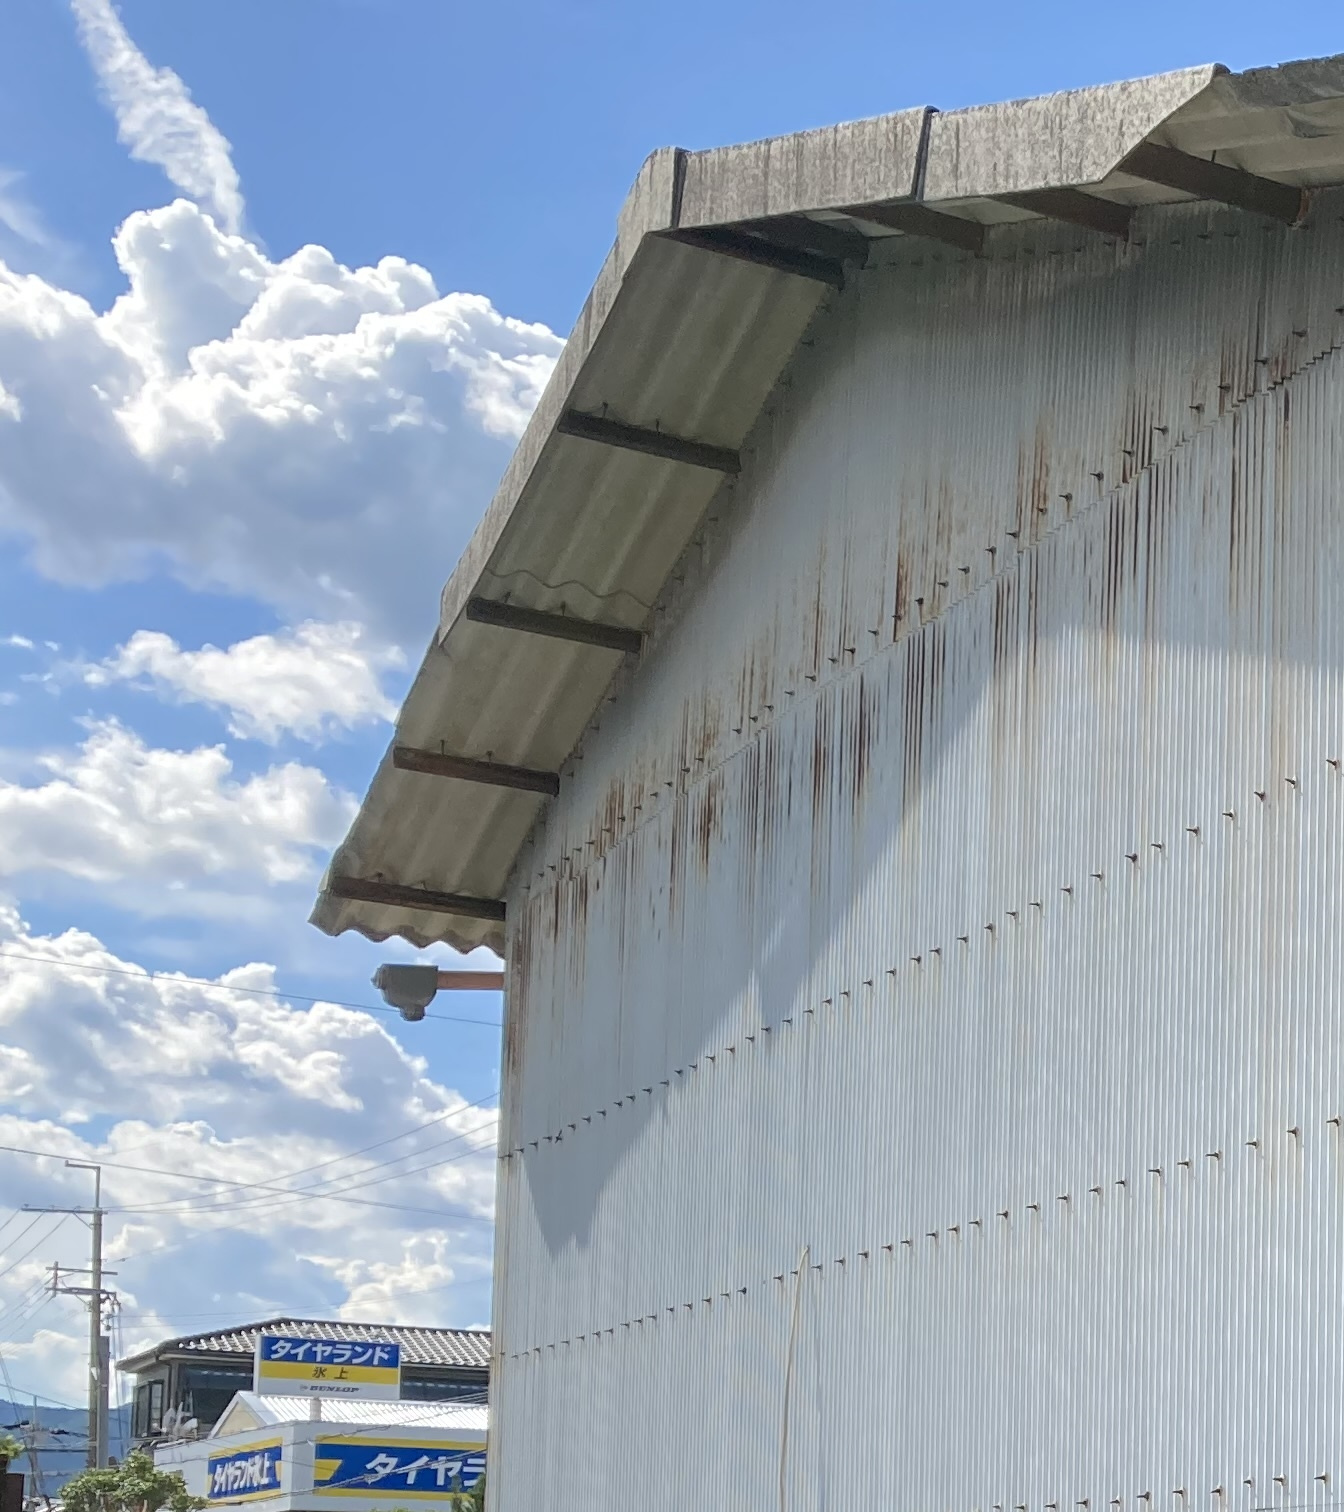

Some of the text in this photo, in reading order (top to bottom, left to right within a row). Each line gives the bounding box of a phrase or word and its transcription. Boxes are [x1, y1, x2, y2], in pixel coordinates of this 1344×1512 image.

[270, 1339, 390, 1365] タイヤランド
[312, 1367, 349, 1380] 氷上
